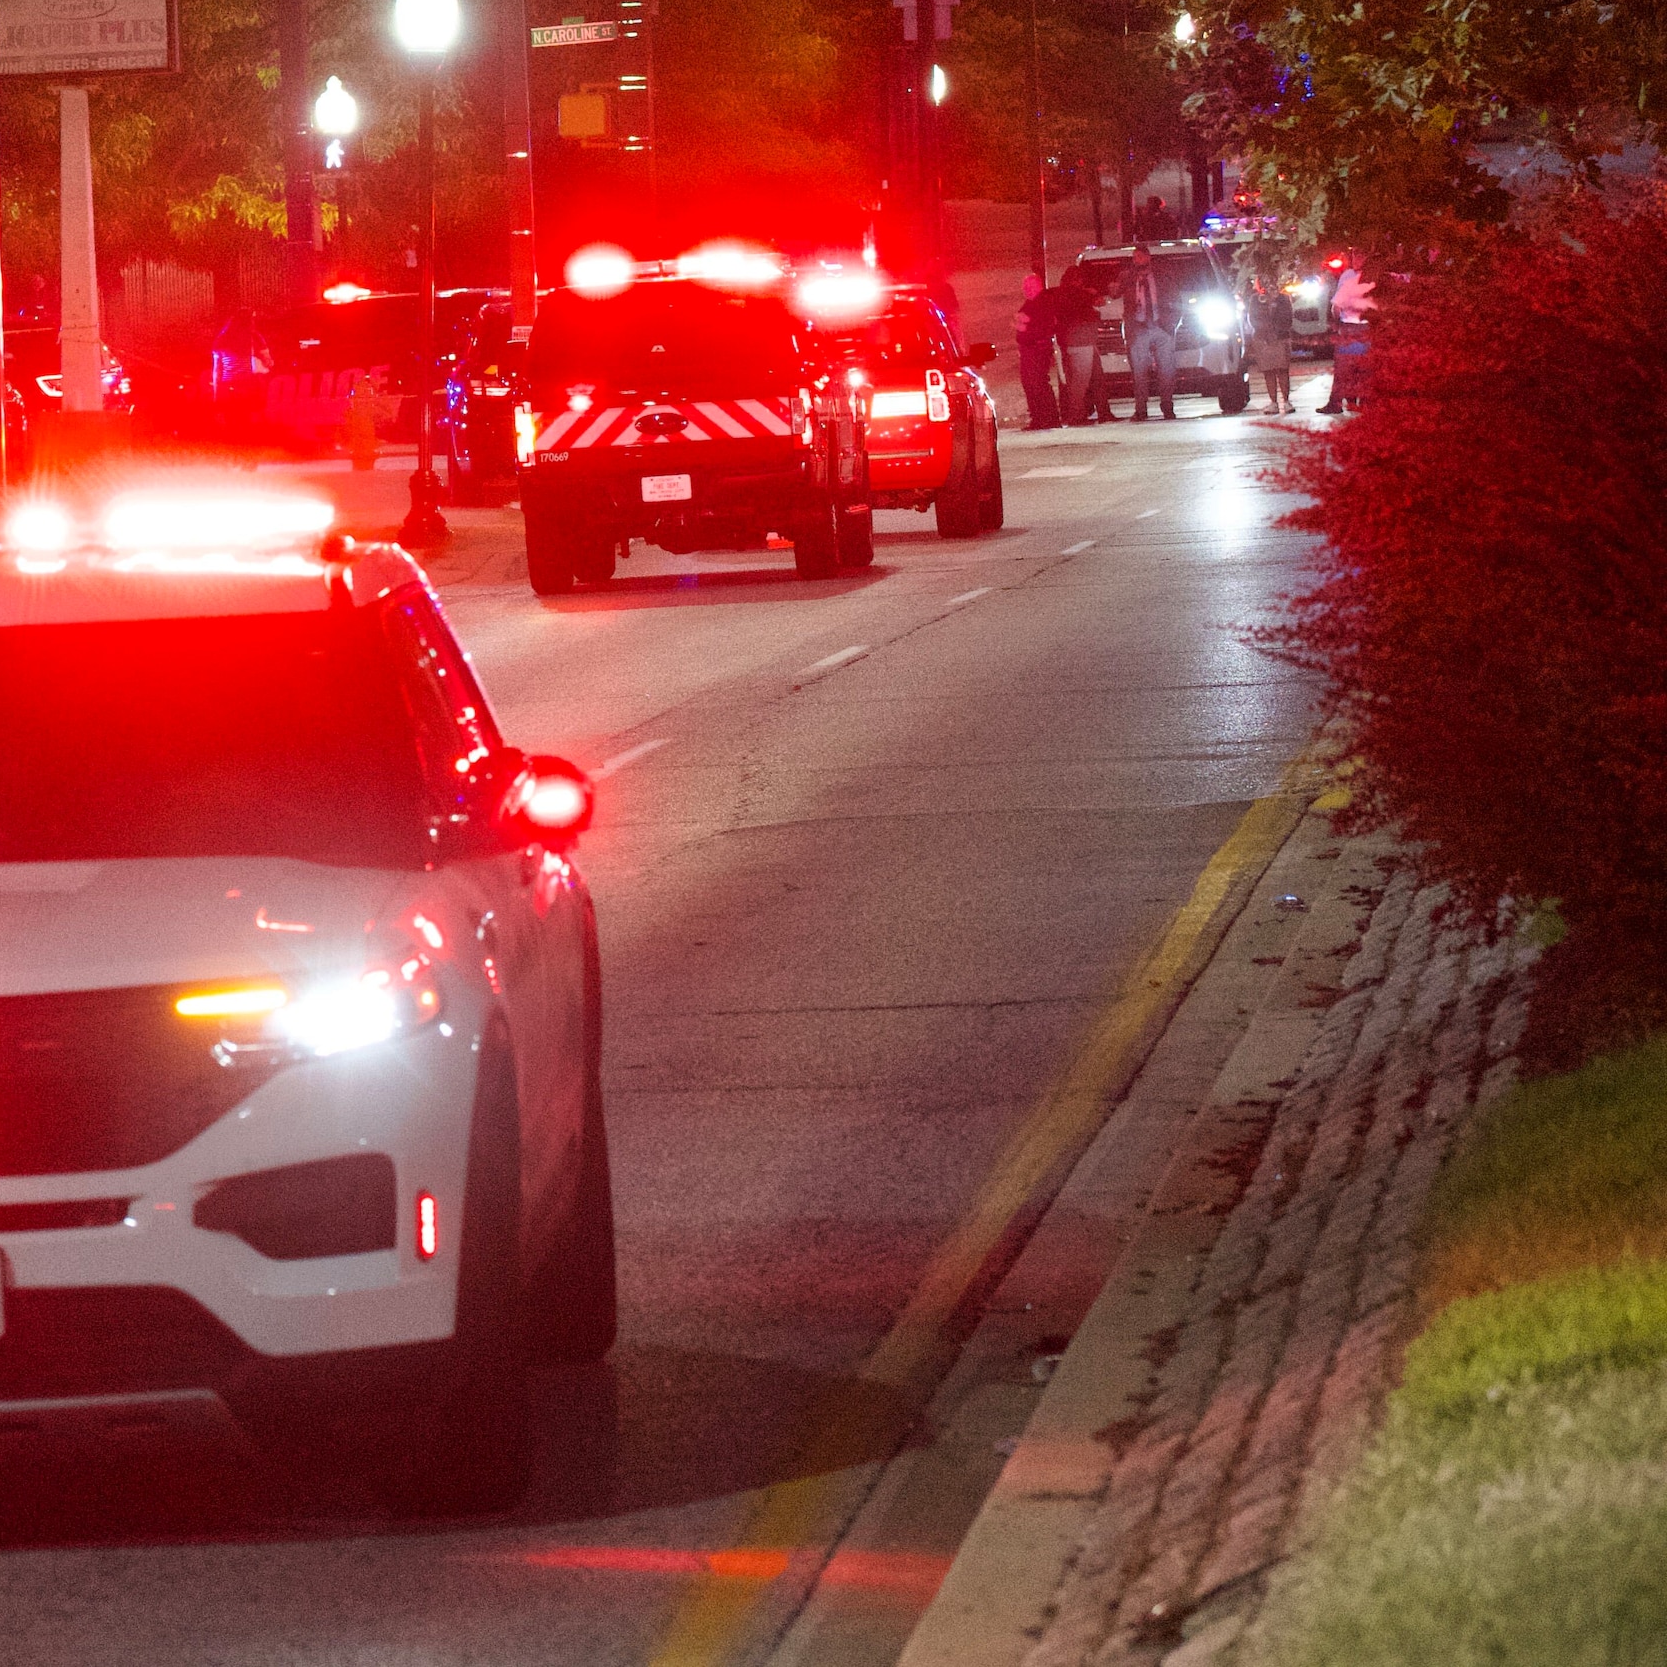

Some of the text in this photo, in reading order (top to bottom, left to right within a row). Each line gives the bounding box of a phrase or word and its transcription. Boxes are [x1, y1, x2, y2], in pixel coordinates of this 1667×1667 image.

[97, 19, 166, 44] PLUS
[267, 364, 391, 401] OLICE
[540, 451, 569, 464] 170669
